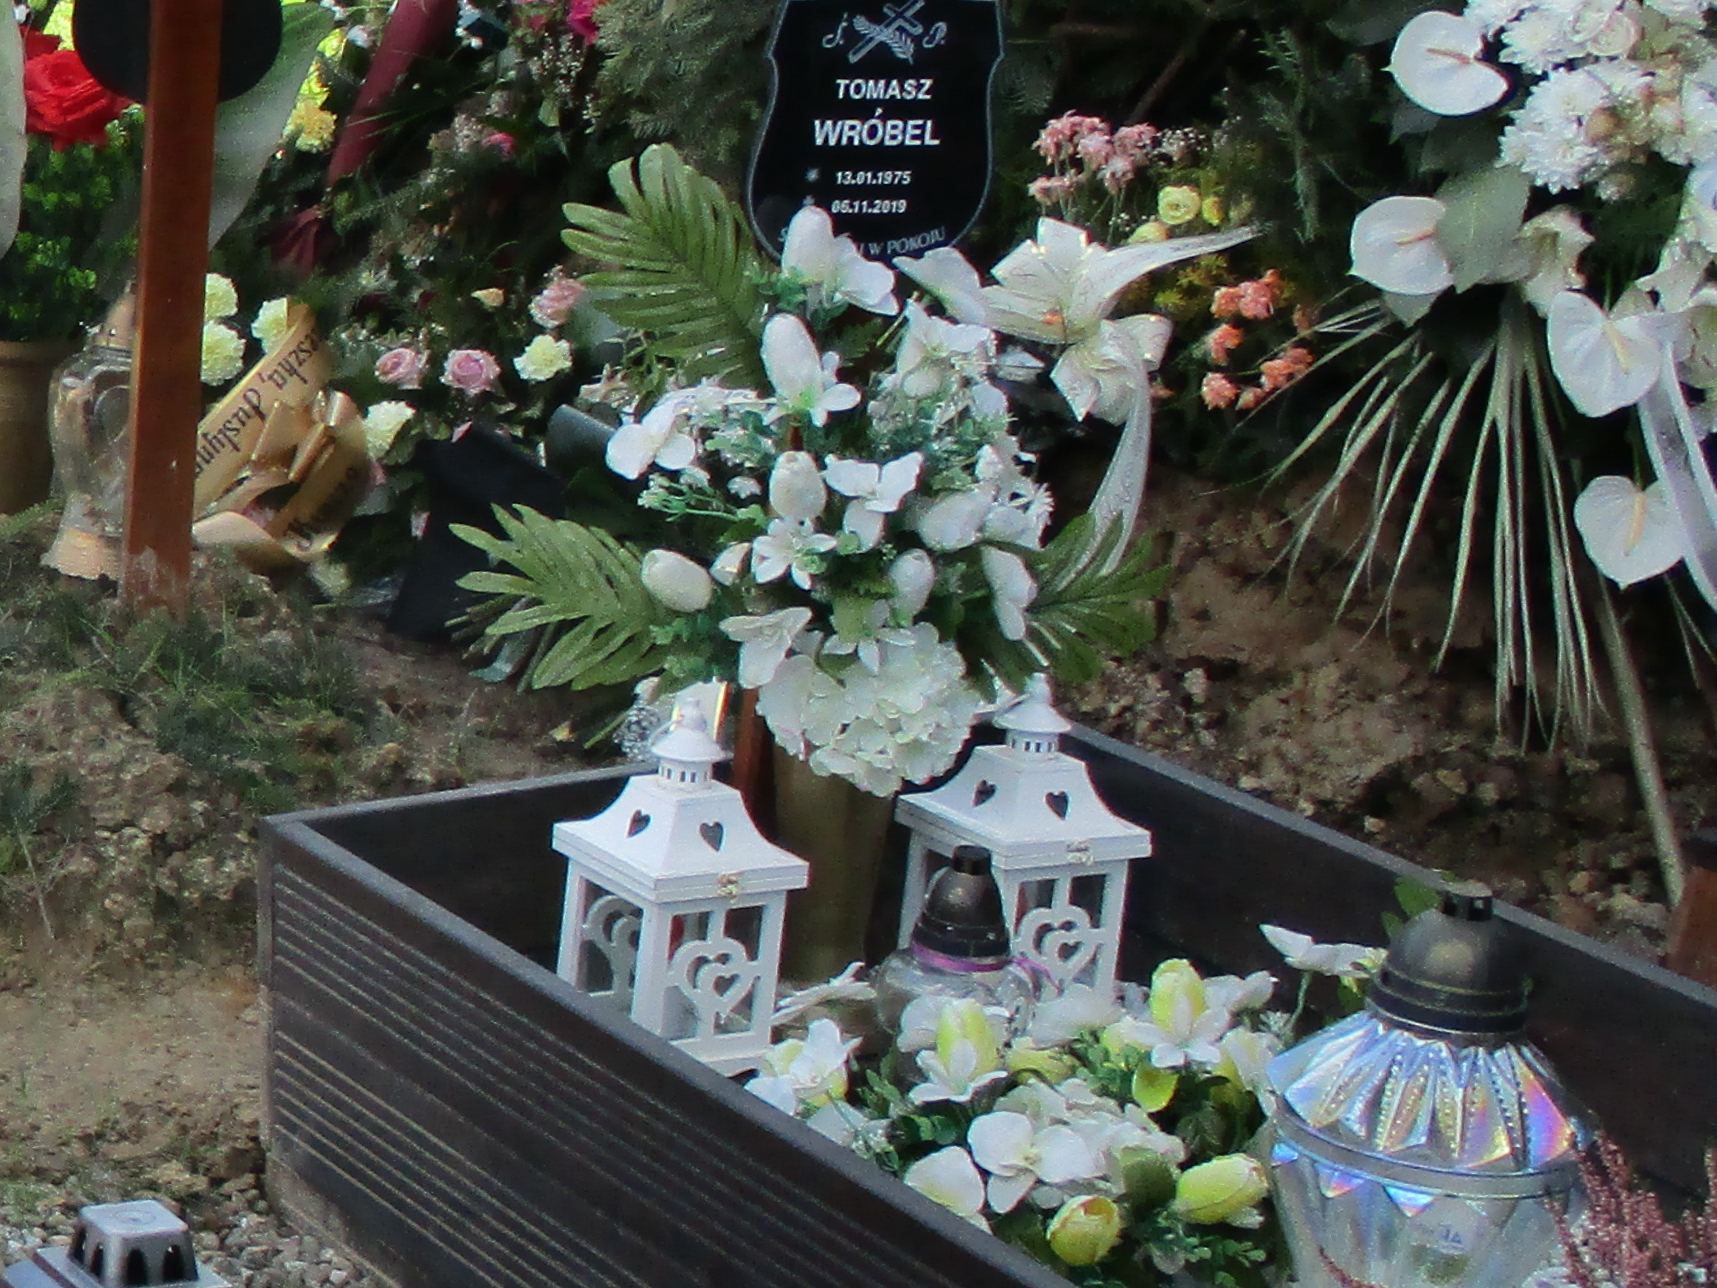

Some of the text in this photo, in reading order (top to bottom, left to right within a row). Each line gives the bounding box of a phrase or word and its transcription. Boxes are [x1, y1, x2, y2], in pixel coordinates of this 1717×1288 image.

[836, 78, 934, 100] TOMASZ
[814, 107, 941, 146] WRÓBEL
[836, 171, 912, 185] 13.01.1975
[868, 243, 885, 255] W
